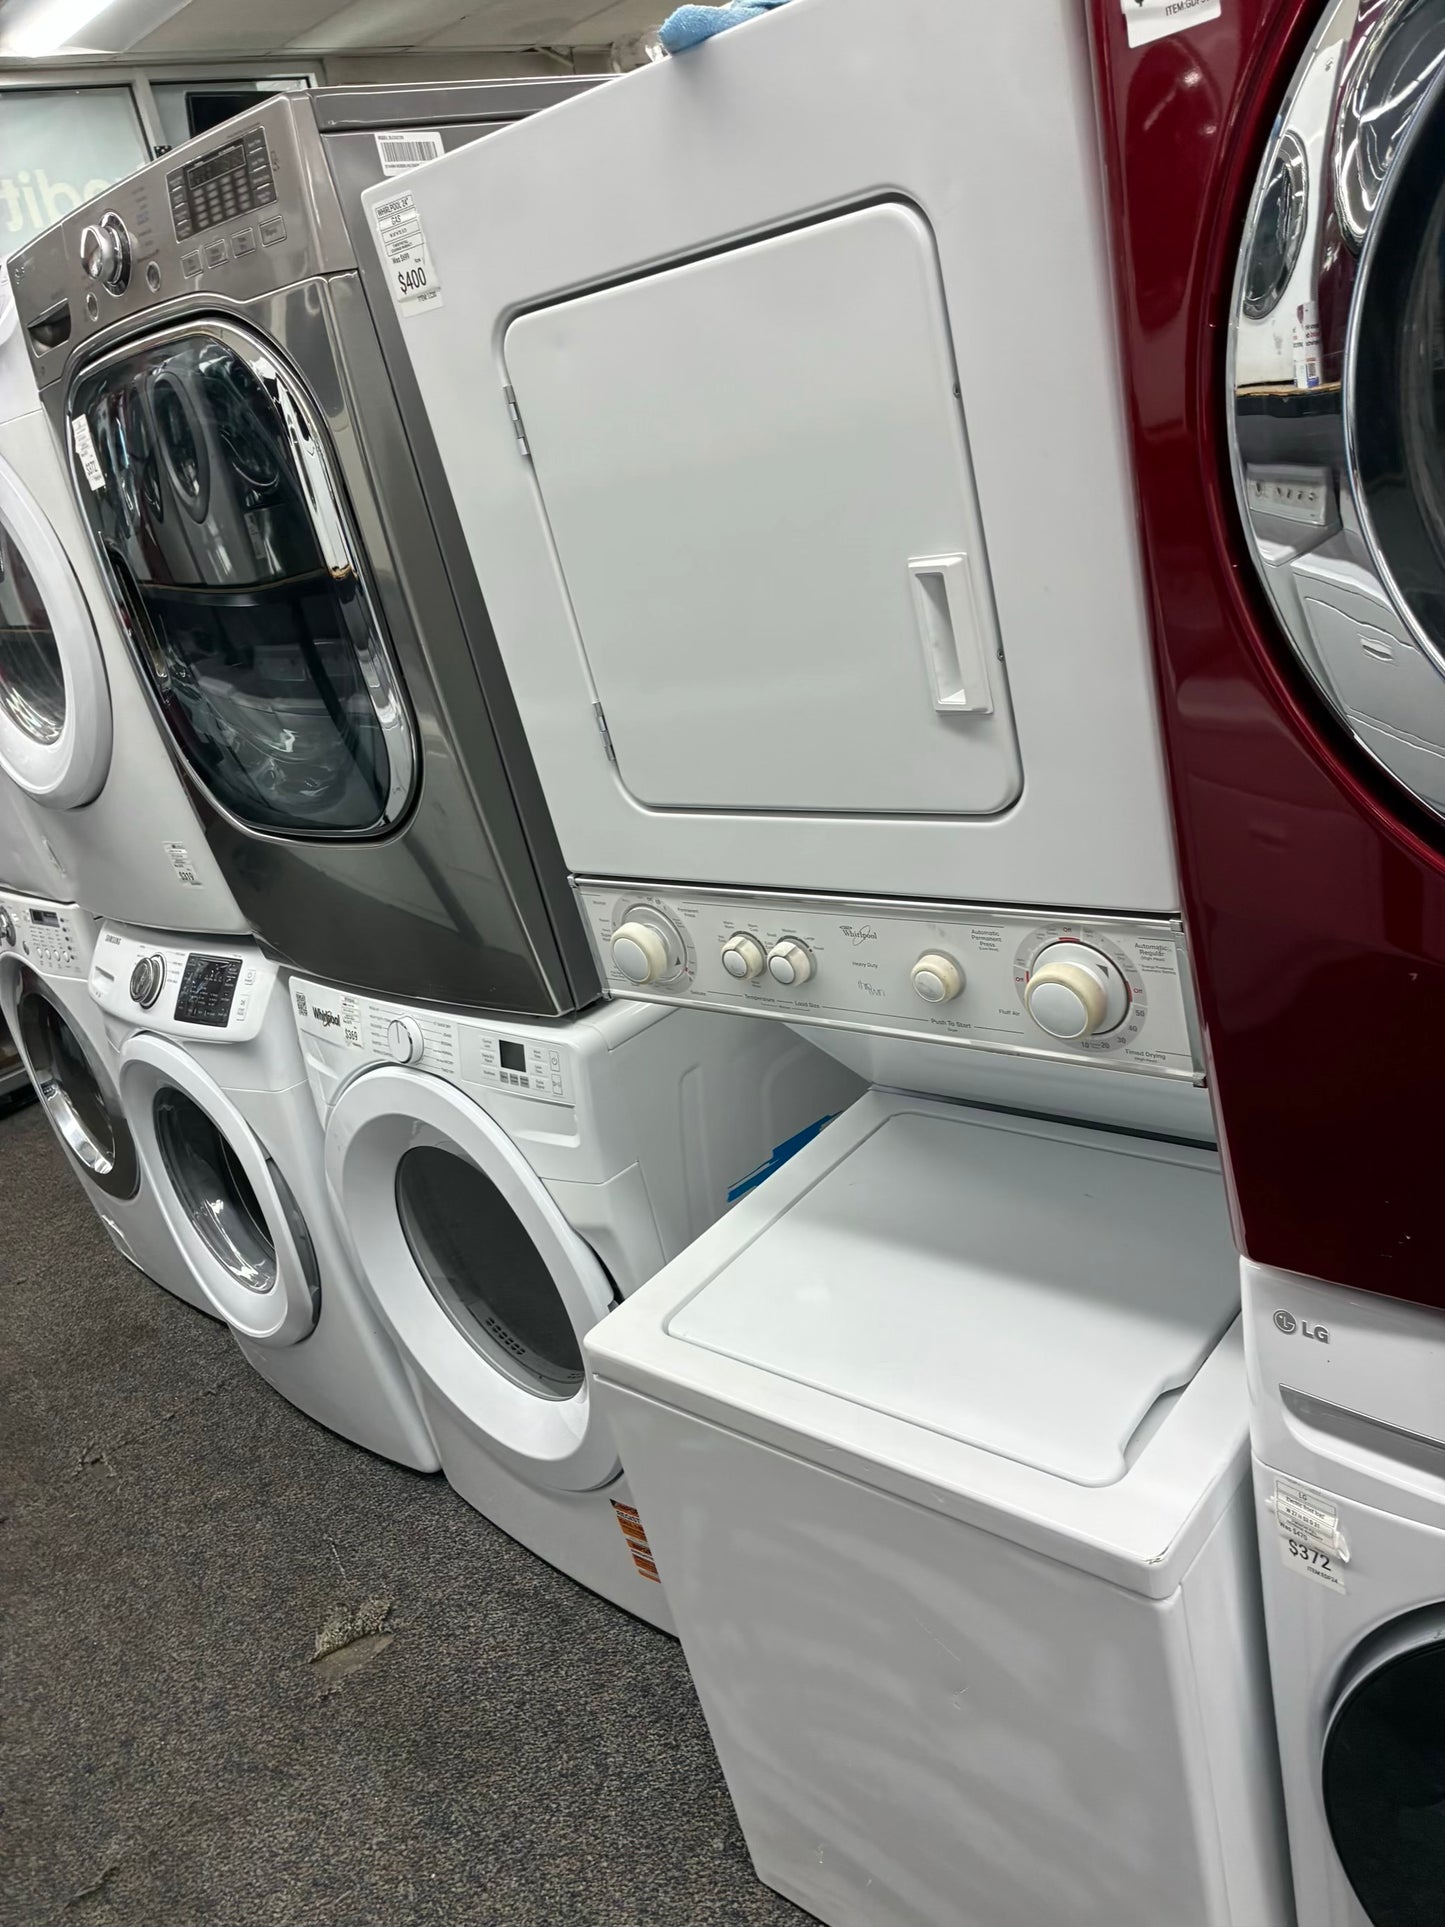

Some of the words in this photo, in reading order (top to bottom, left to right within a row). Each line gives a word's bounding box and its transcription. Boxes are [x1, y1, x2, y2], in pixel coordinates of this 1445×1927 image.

[391, 214, 401, 226] GAS
[398, 267, 427, 295] $400
[840, 926, 878, 943] Whirlpool
[971, 929, 1000, 937] Automatic
[971, 934, 1002, 943] Permanent
[1134, 942, 1167, 951] Automatic
[1139, 949, 1166, 958] Regular
[312, 1006, 341, 1027] Whirlpool
[930, 1018, 947, 1026] Push
[956, 1021, 971, 1029] Start
[1081, 1041, 1090, 1049] 10
[1125, 1048, 1144, 1057] Timed
[1145, 1051, 1166, 1060] Drying
[1302, 1319, 1330, 1344] LG
[1298, 1492, 1307, 1501] LG
[1279, 1522, 1292, 1532] Was
[1289, 1539, 1331, 1571] $372
